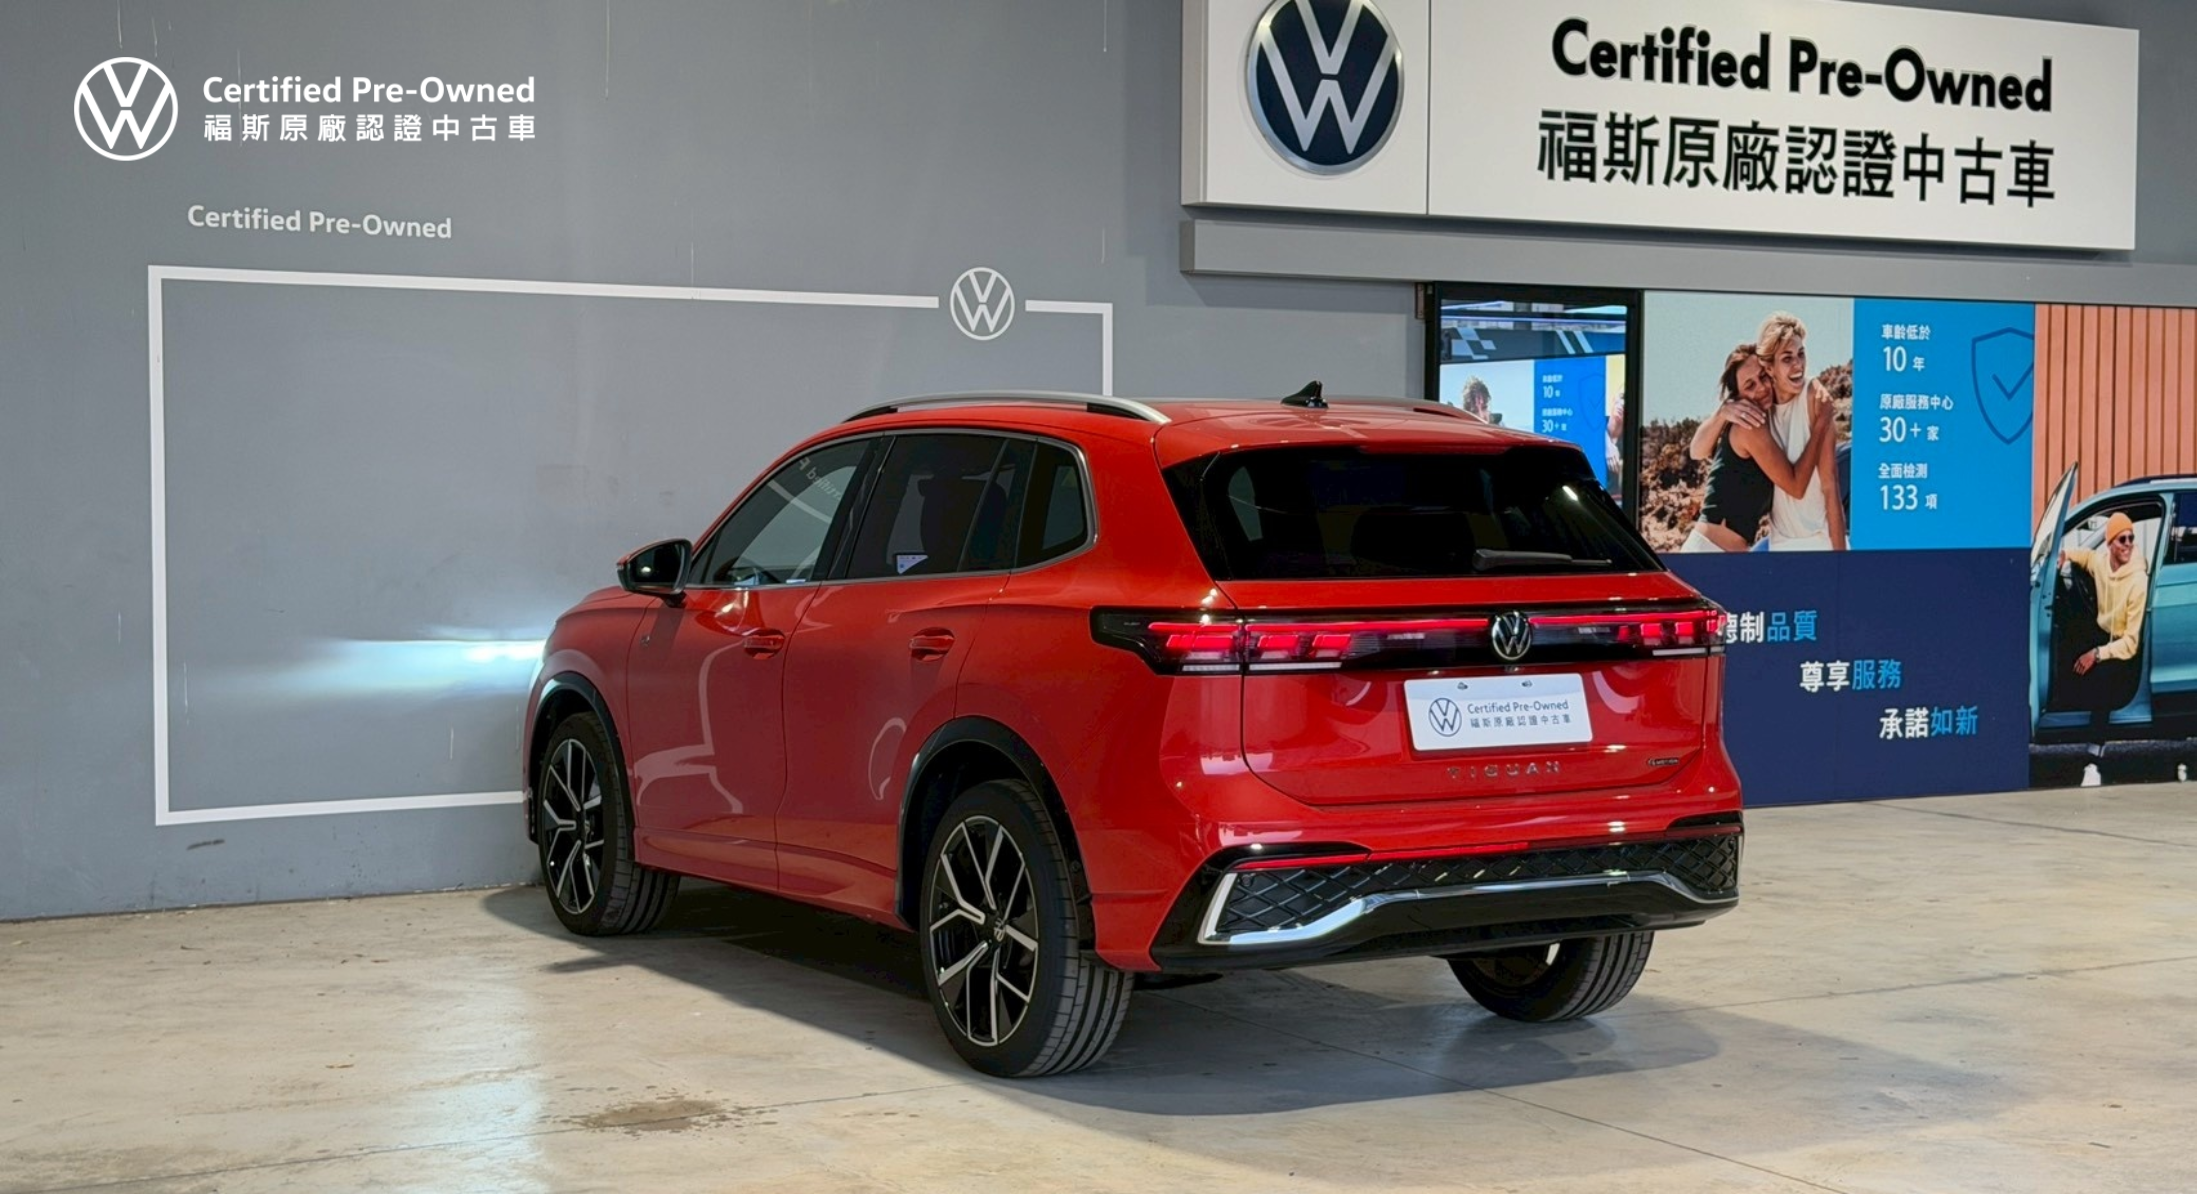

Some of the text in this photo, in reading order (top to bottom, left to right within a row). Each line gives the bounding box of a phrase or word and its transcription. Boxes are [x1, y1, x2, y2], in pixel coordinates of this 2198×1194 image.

[1552, 18, 2052, 112] Certified Pre-Owned
[1537, 108, 2056, 208] 福斯原廠認證中古車
[188, 205, 452, 239] Certified Pre-Owned
[1881, 324, 1931, 340] 車齡低於
[1883, 346, 1925, 372] 10 年
[1879, 393, 1954, 410] 原廠服務中心
[1926, 425, 1940, 441] 家
[1878, 463, 1928, 479] 全面檢測
[1879, 484, 1938, 511] 133 項
[1800, 659, 1902, 692] 尊享服務
[1467, 699, 1569, 714] Certified Pre-Owned
[1879, 706, 1979, 740] 承諾如新
